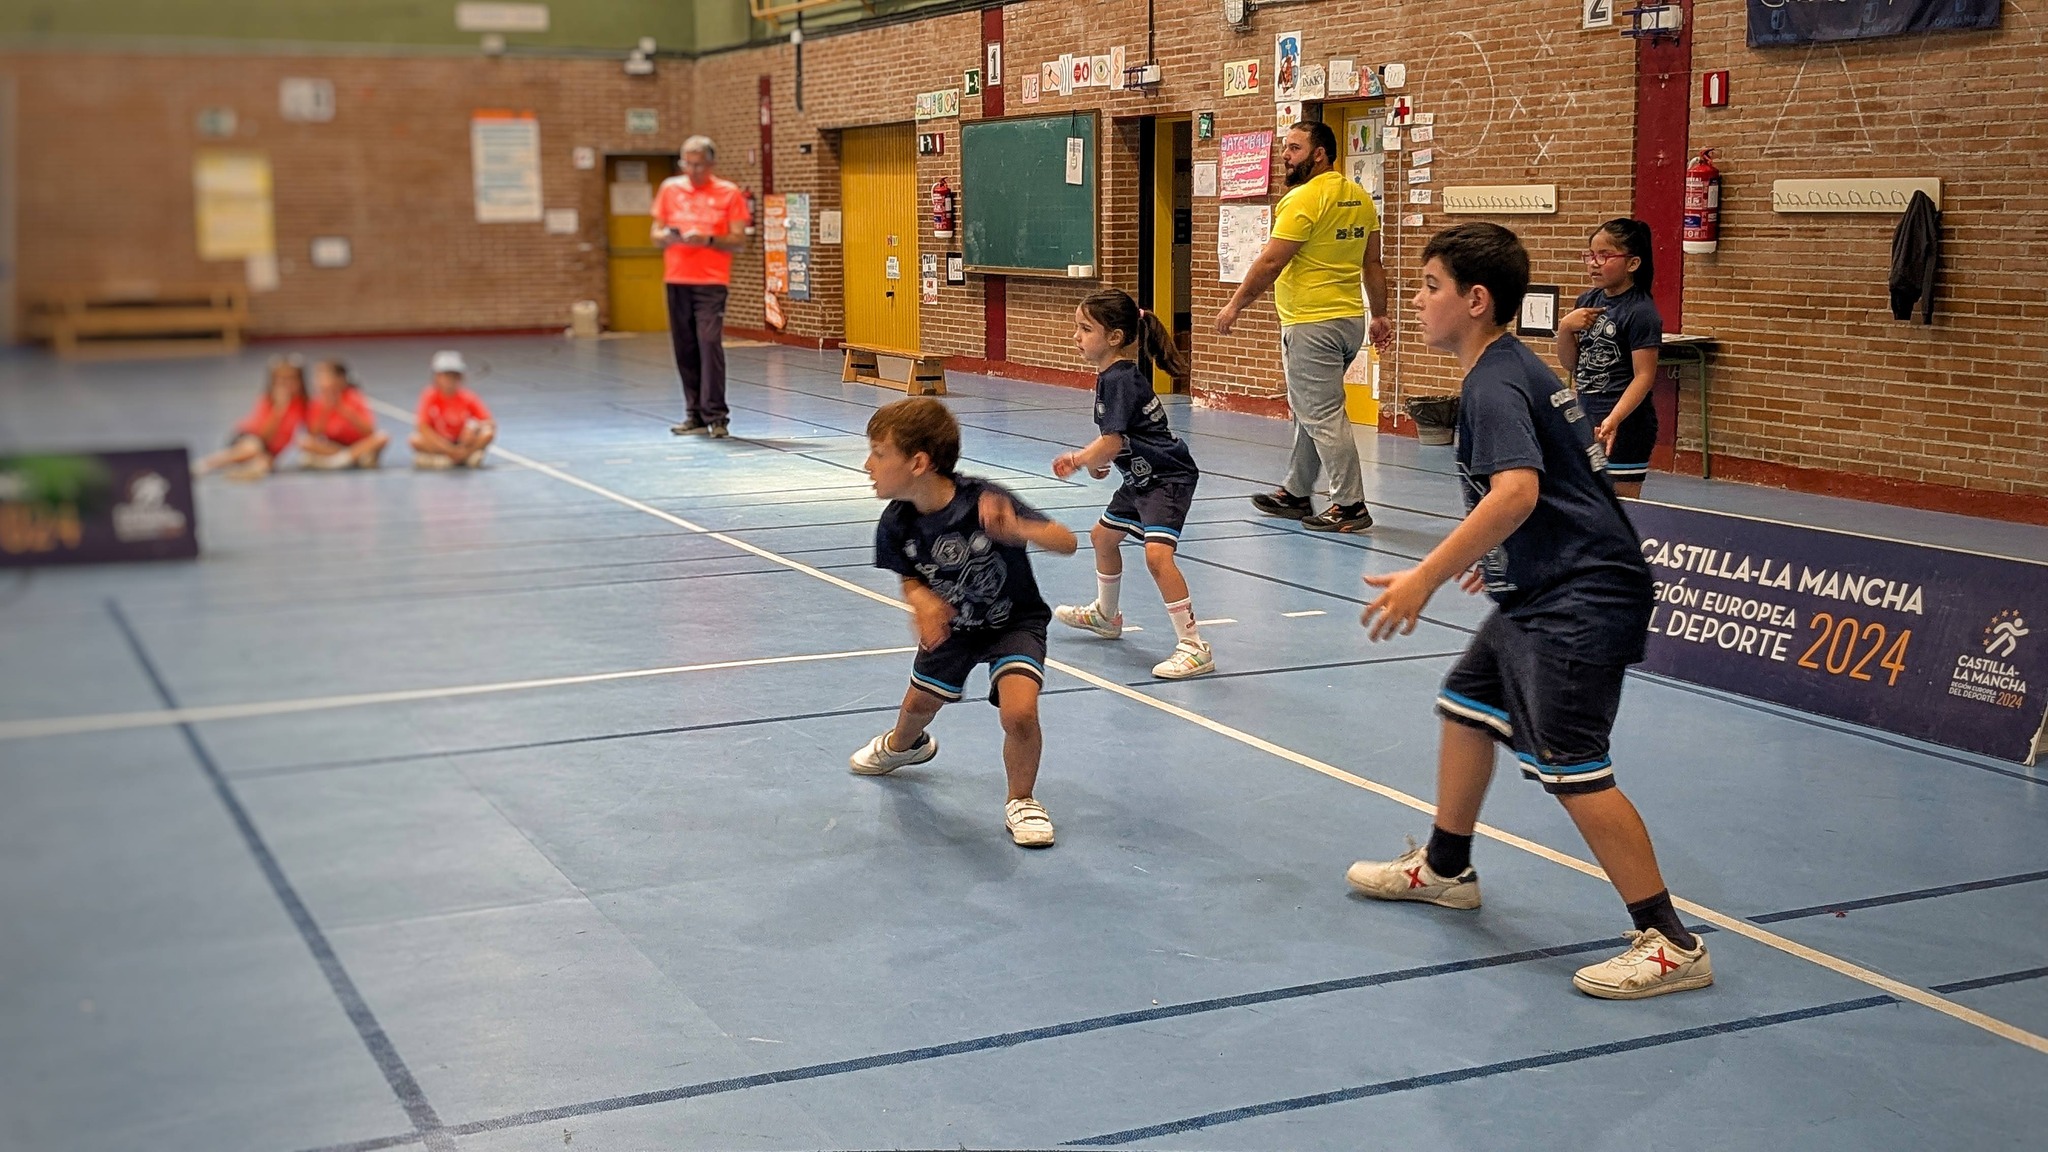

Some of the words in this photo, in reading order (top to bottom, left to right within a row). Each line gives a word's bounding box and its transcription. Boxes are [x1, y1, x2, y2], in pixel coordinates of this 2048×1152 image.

[989, 48, 1000, 81] 1
[1225, 63, 1259, 92] PAZ
[1641, 538, 1791, 590] CASTILLA-LA
[1798, 566, 1923, 615] MANCHA
[1653, 577, 1699, 608] GIÓN
[1701, 592, 1796, 629] EUROPEA
[1667, 611, 1792, 661] DEPORTE
[1798, 612, 1911, 686] 2024
[1953, 667, 1969, 681] LA
[1971, 671, 2026, 693] MANCHA
[1958, 655, 2020, 677] CASTILLA-
[1948, 687, 1962, 696] DEL
[1962, 690, 1996, 704] DEPORTE
[1996, 691, 2024, 709] 2024
